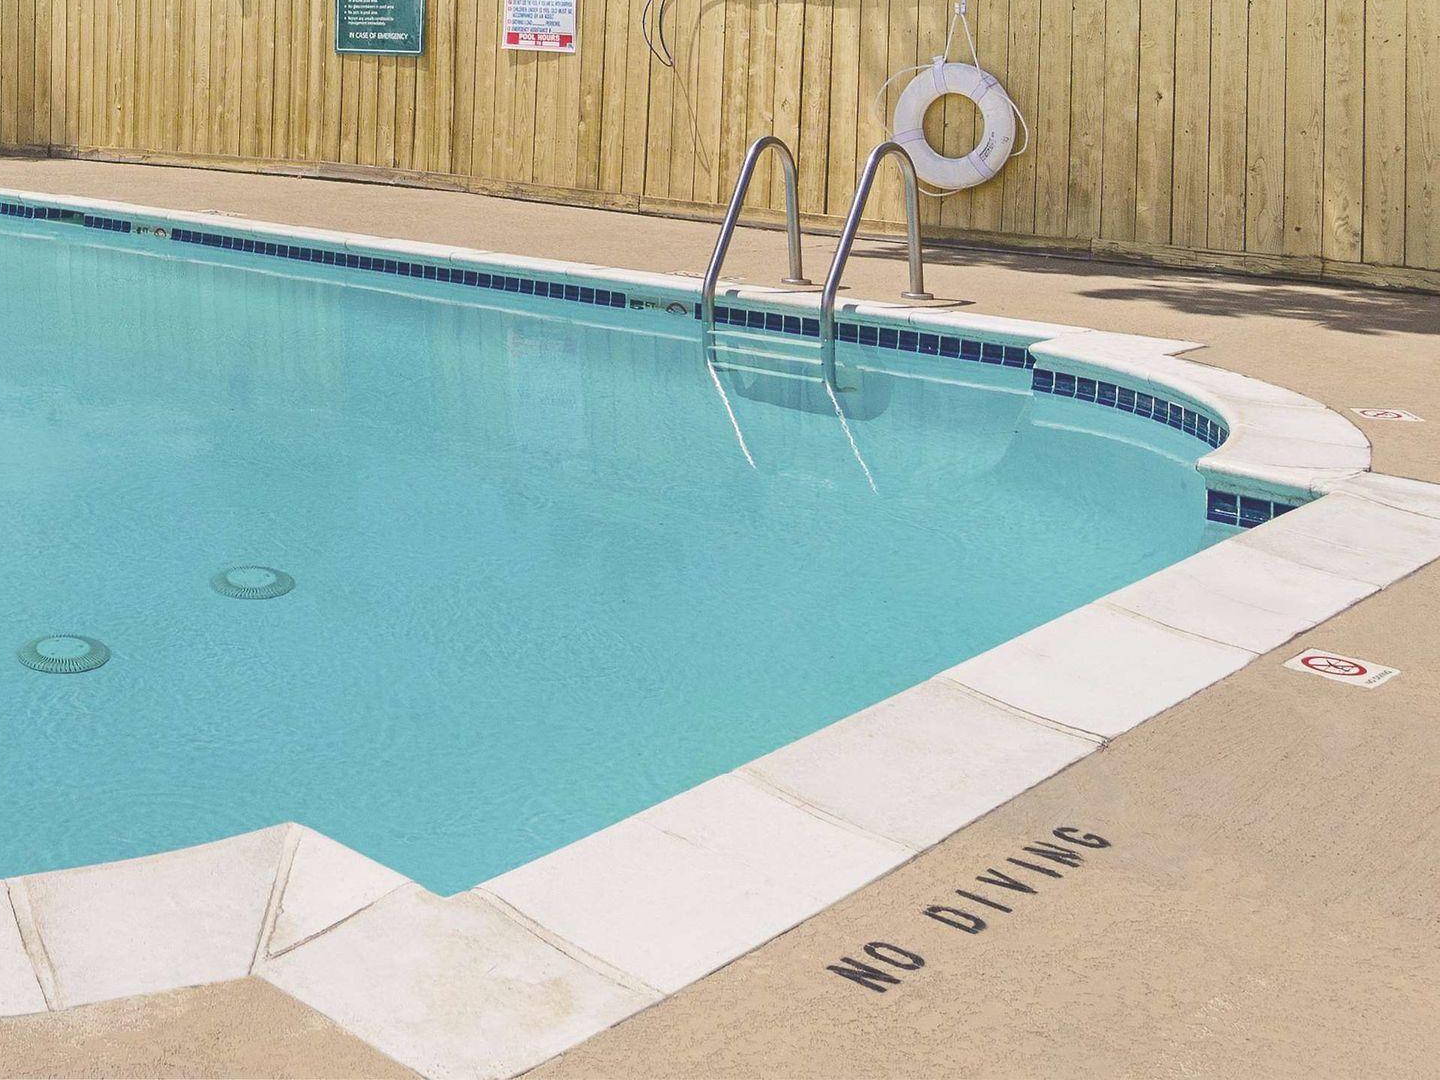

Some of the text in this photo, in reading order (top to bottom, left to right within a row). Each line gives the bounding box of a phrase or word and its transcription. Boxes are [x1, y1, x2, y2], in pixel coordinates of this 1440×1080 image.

[377, 32, 409, 40] EMERGENCY
[519, 33, 536, 41] POOL
[825, 826, 1113, 994] NO DIVING
